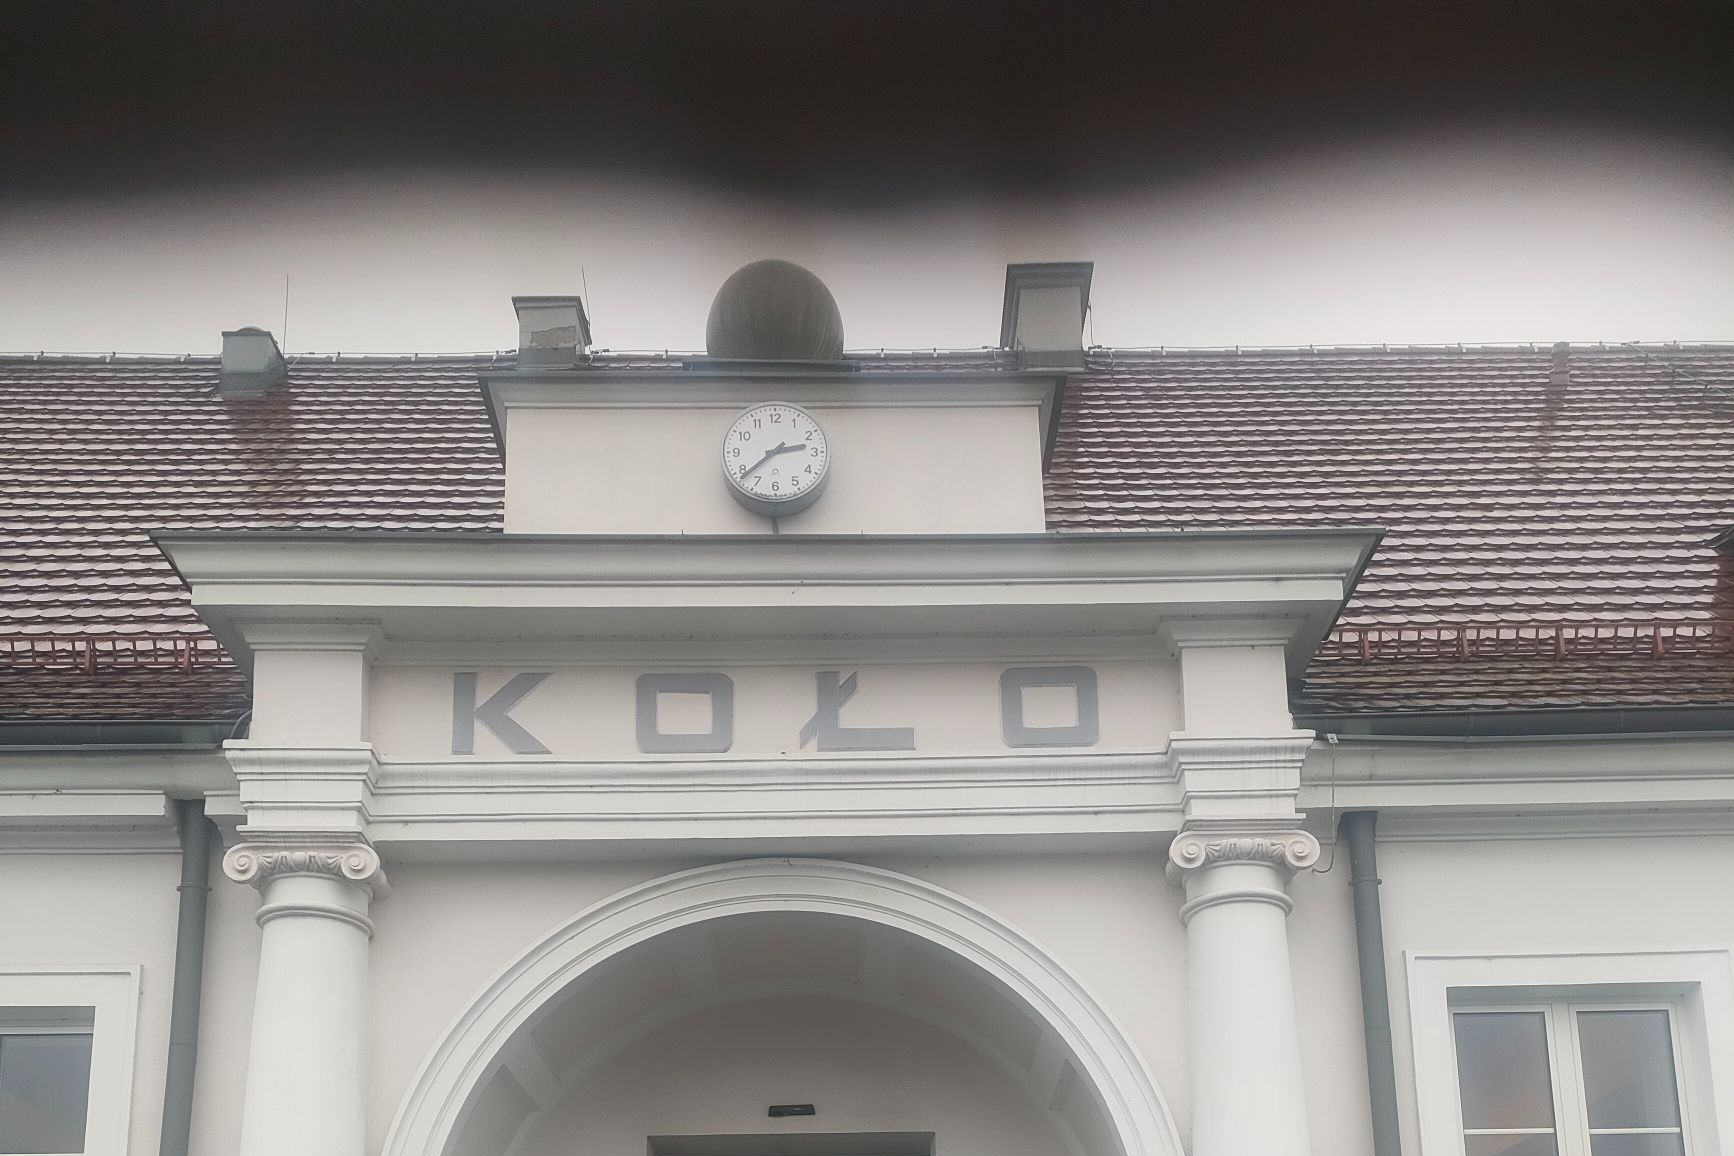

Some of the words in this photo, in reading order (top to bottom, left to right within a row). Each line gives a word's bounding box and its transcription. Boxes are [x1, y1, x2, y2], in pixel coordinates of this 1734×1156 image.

[753, 418, 762, 429] 11
[769, 413, 782, 424] 12
[792, 418, 796, 429] 1
[739, 431, 751, 441] 10
[805, 430, 813, 441] 2
[732, 447, 740, 457] 9
[810, 447, 819, 457] 3
[739, 464, 747, 475] 8
[804, 464, 812, 475] 4
[754, 476, 762, 487] 7
[771, 481, 780, 491] 6
[791, 476, 799, 486] 5
[452, 666, 1100, 756] KOŁO
